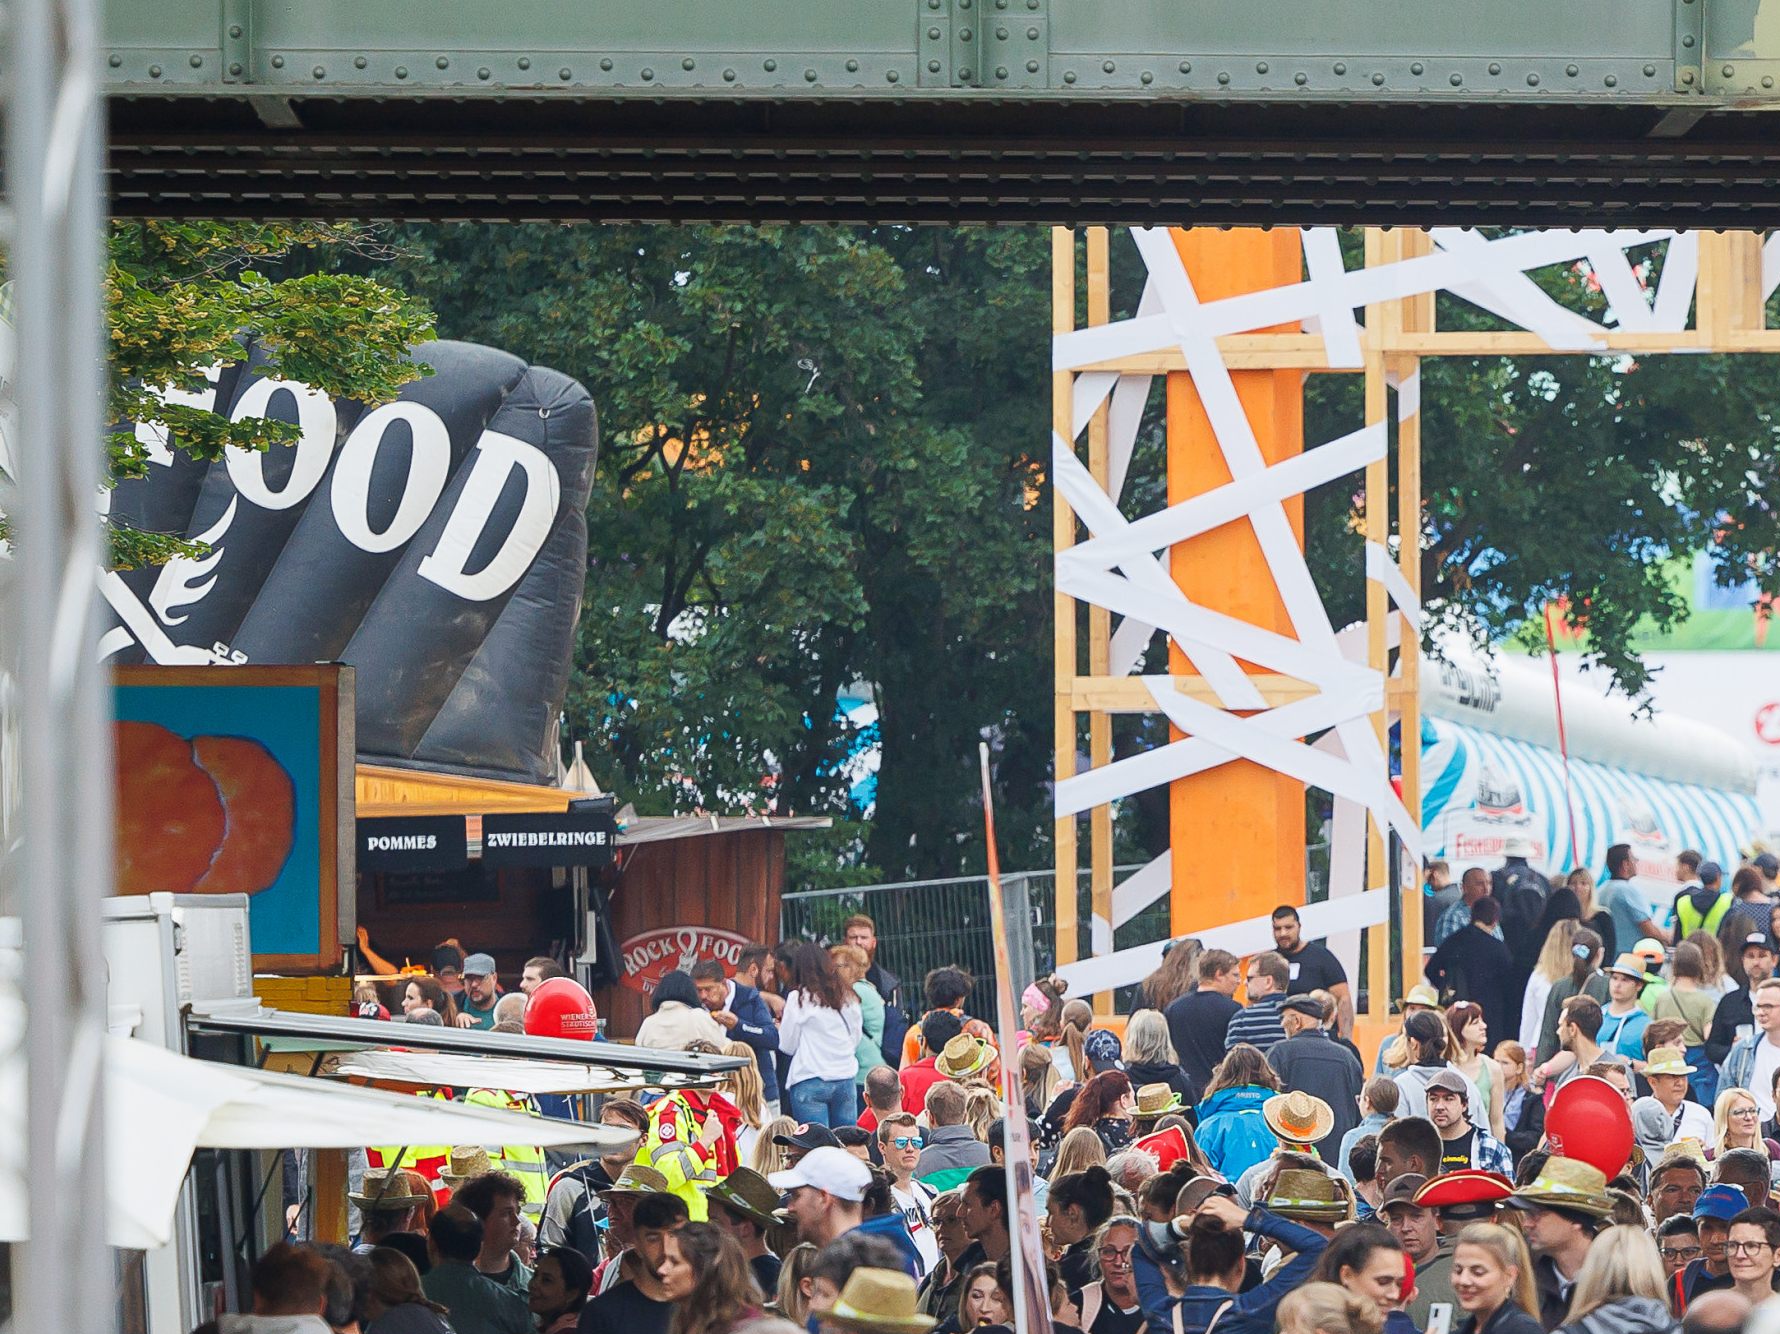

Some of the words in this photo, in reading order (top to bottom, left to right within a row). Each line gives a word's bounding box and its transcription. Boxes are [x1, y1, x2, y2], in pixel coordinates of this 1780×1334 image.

[368, 835, 437, 851] POMMES
[487, 831, 606, 847] ZWIEBELRINGE
[622, 937, 677, 977] ROCK
[700, 934, 743, 966] FOO
